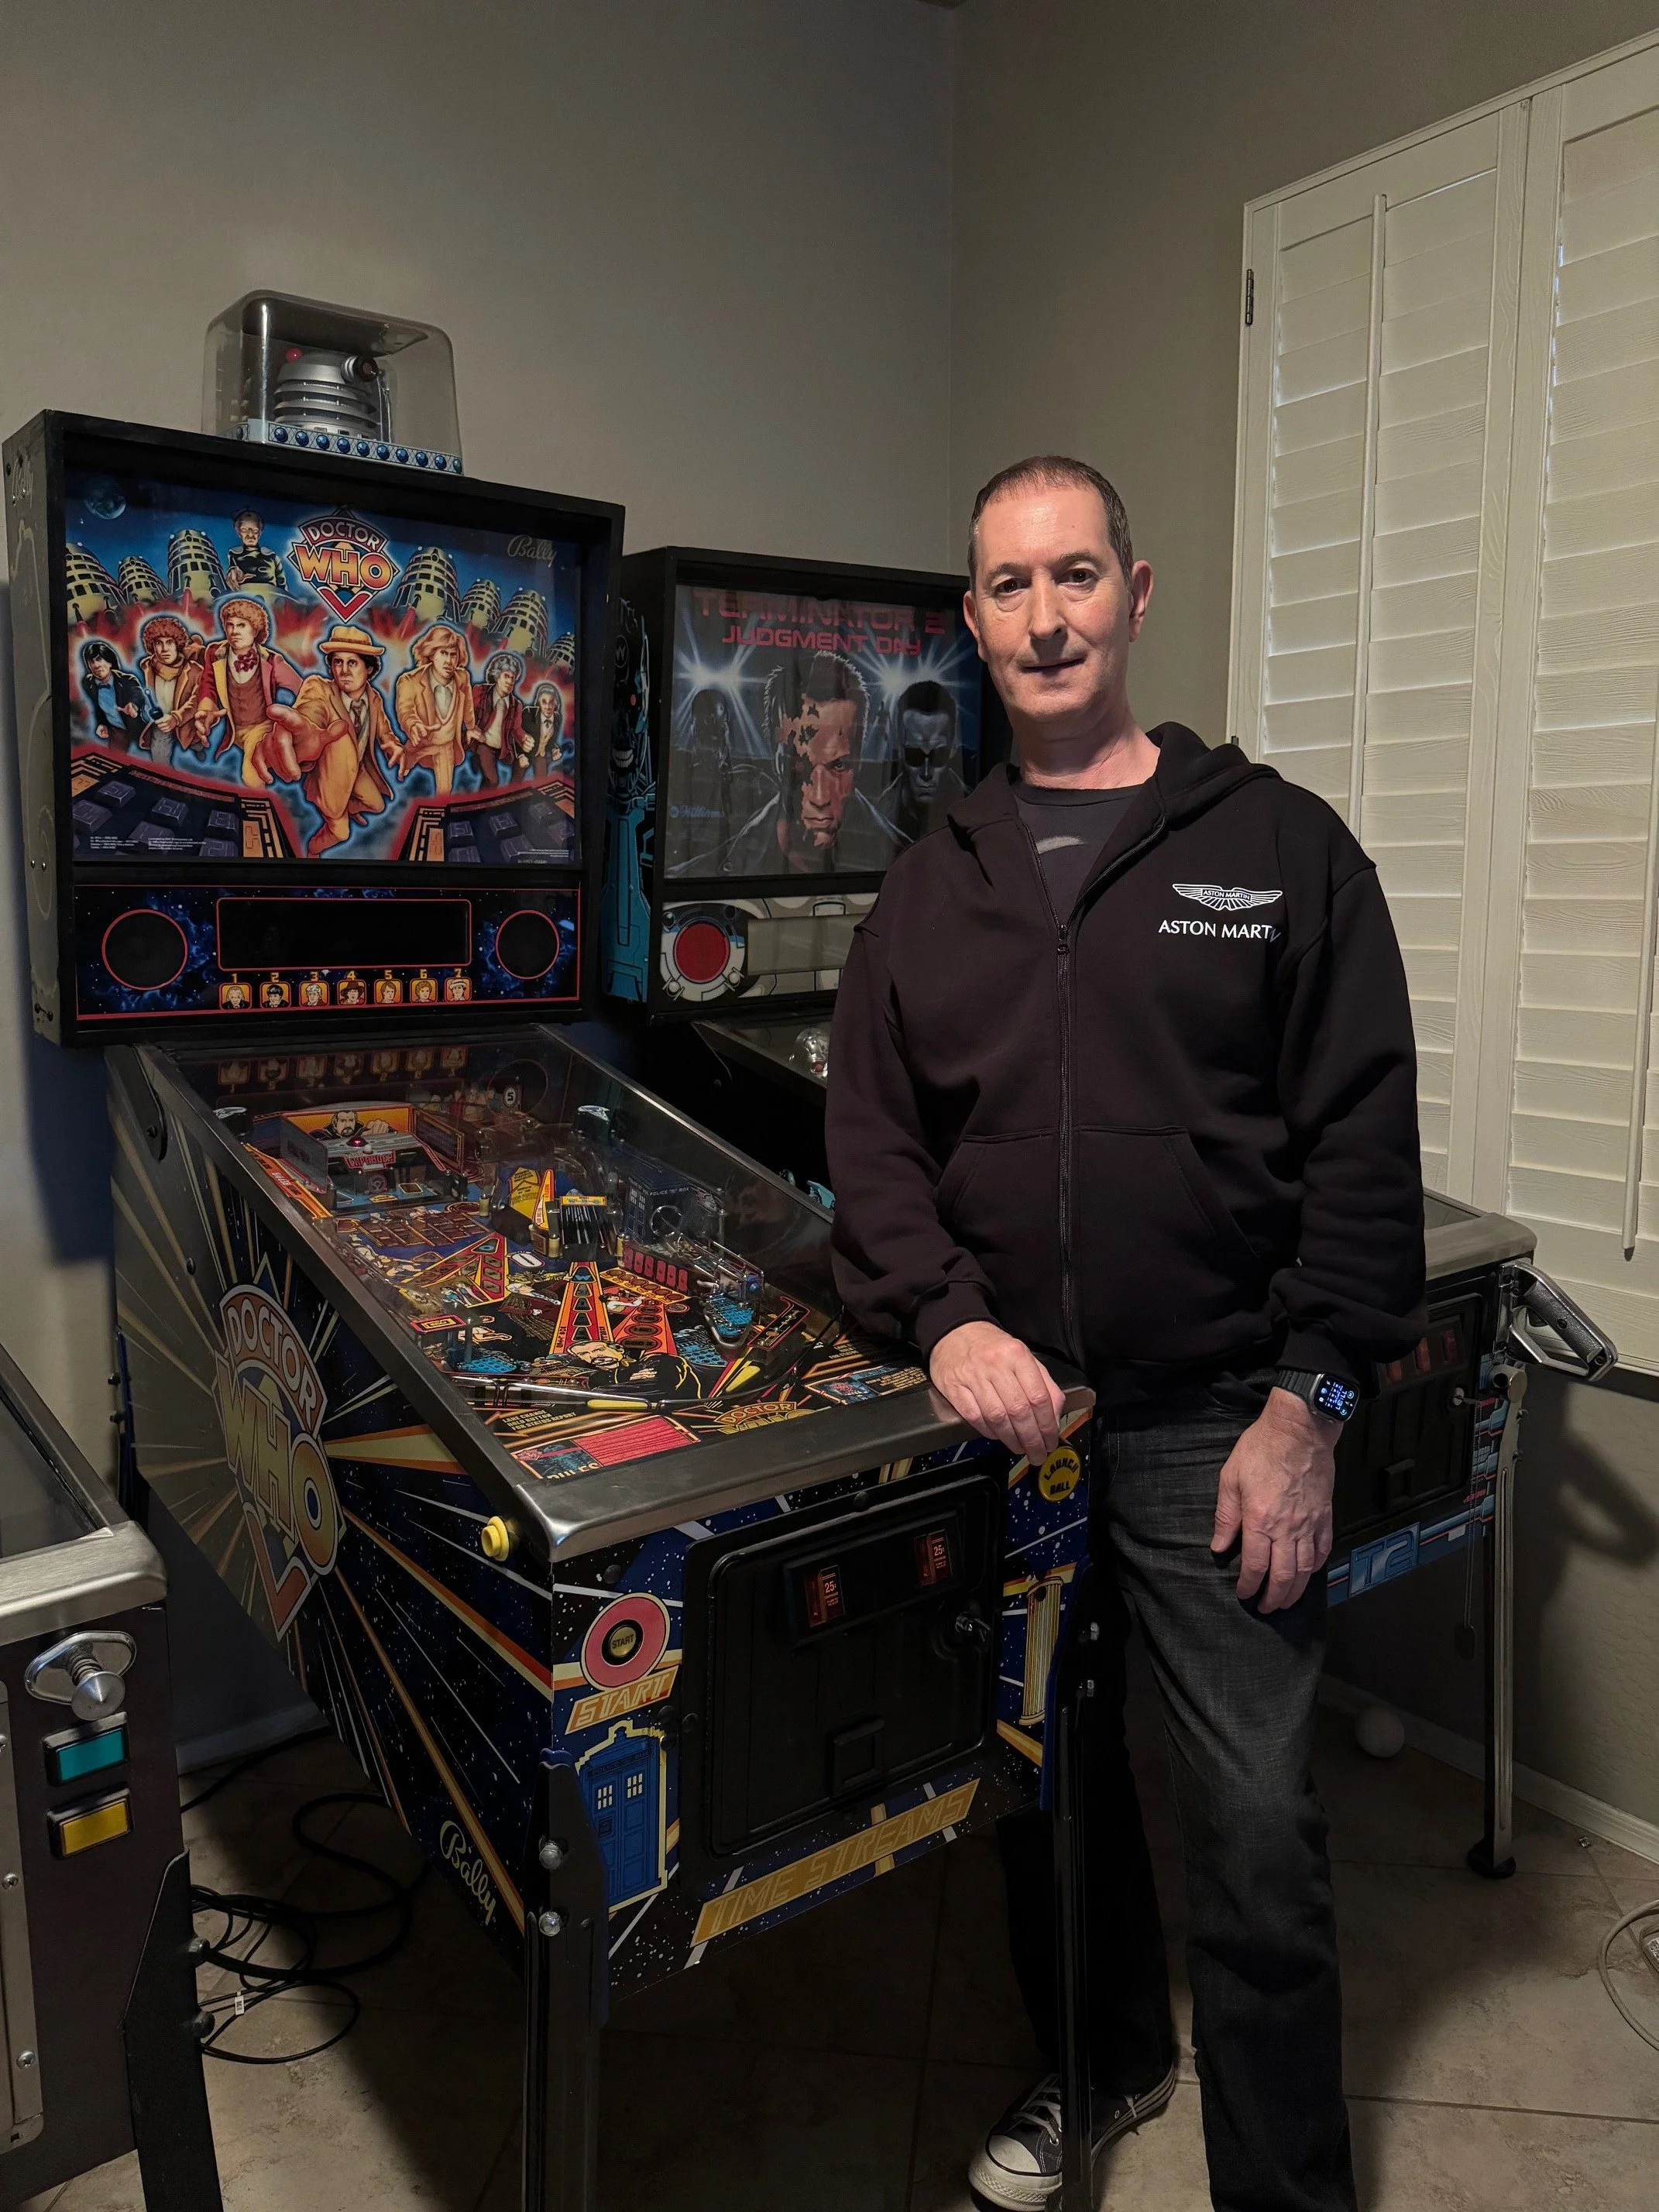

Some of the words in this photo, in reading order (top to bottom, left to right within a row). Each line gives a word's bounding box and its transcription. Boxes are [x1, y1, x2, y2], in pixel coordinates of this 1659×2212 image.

[309, 520, 380, 550] DOCTOR
[507, 534, 558, 568] Bally
[293, 542, 392, 590] WHO
[692, 589, 915, 631] TERMINATOR
[925, 609, 946, 635] 2
[722, 624, 868, 653] JUDGMENT
[876, 635, 922, 656] DAY
[1158, 919, 1216, 938] ASTON
[232, 973, 238, 984] 1
[270, 972, 280, 983] 2
[310, 970, 319, 981] 3
[346, 970, 356, 981] 4
[384, 970, 393, 980] 5
[420, 968, 428, 979] 6
[454, 968, 462, 978] 7
[507, 1092, 514, 1101] 5
[227, 1297, 318, 1415] DOCTOR
[527, 1418, 551, 1427] STATUS
[551, 1411, 577, 1421] REPORT
[721, 1403, 792, 1423] DOCTOR
[215, 1352, 339, 1575] WHO
[1043, 1458, 1079, 1480] LAUNCH
[1049, 1481, 1070, 1495] BALL
[1355, 1530, 1415, 1587] T2
[612, 1633, 634, 1649] START
[575, 1672, 669, 1728] START
[440, 1820, 496, 1925] Bally
[711, 1871, 795, 1931] TIME
[805, 1794, 966, 1886] STREAMS
